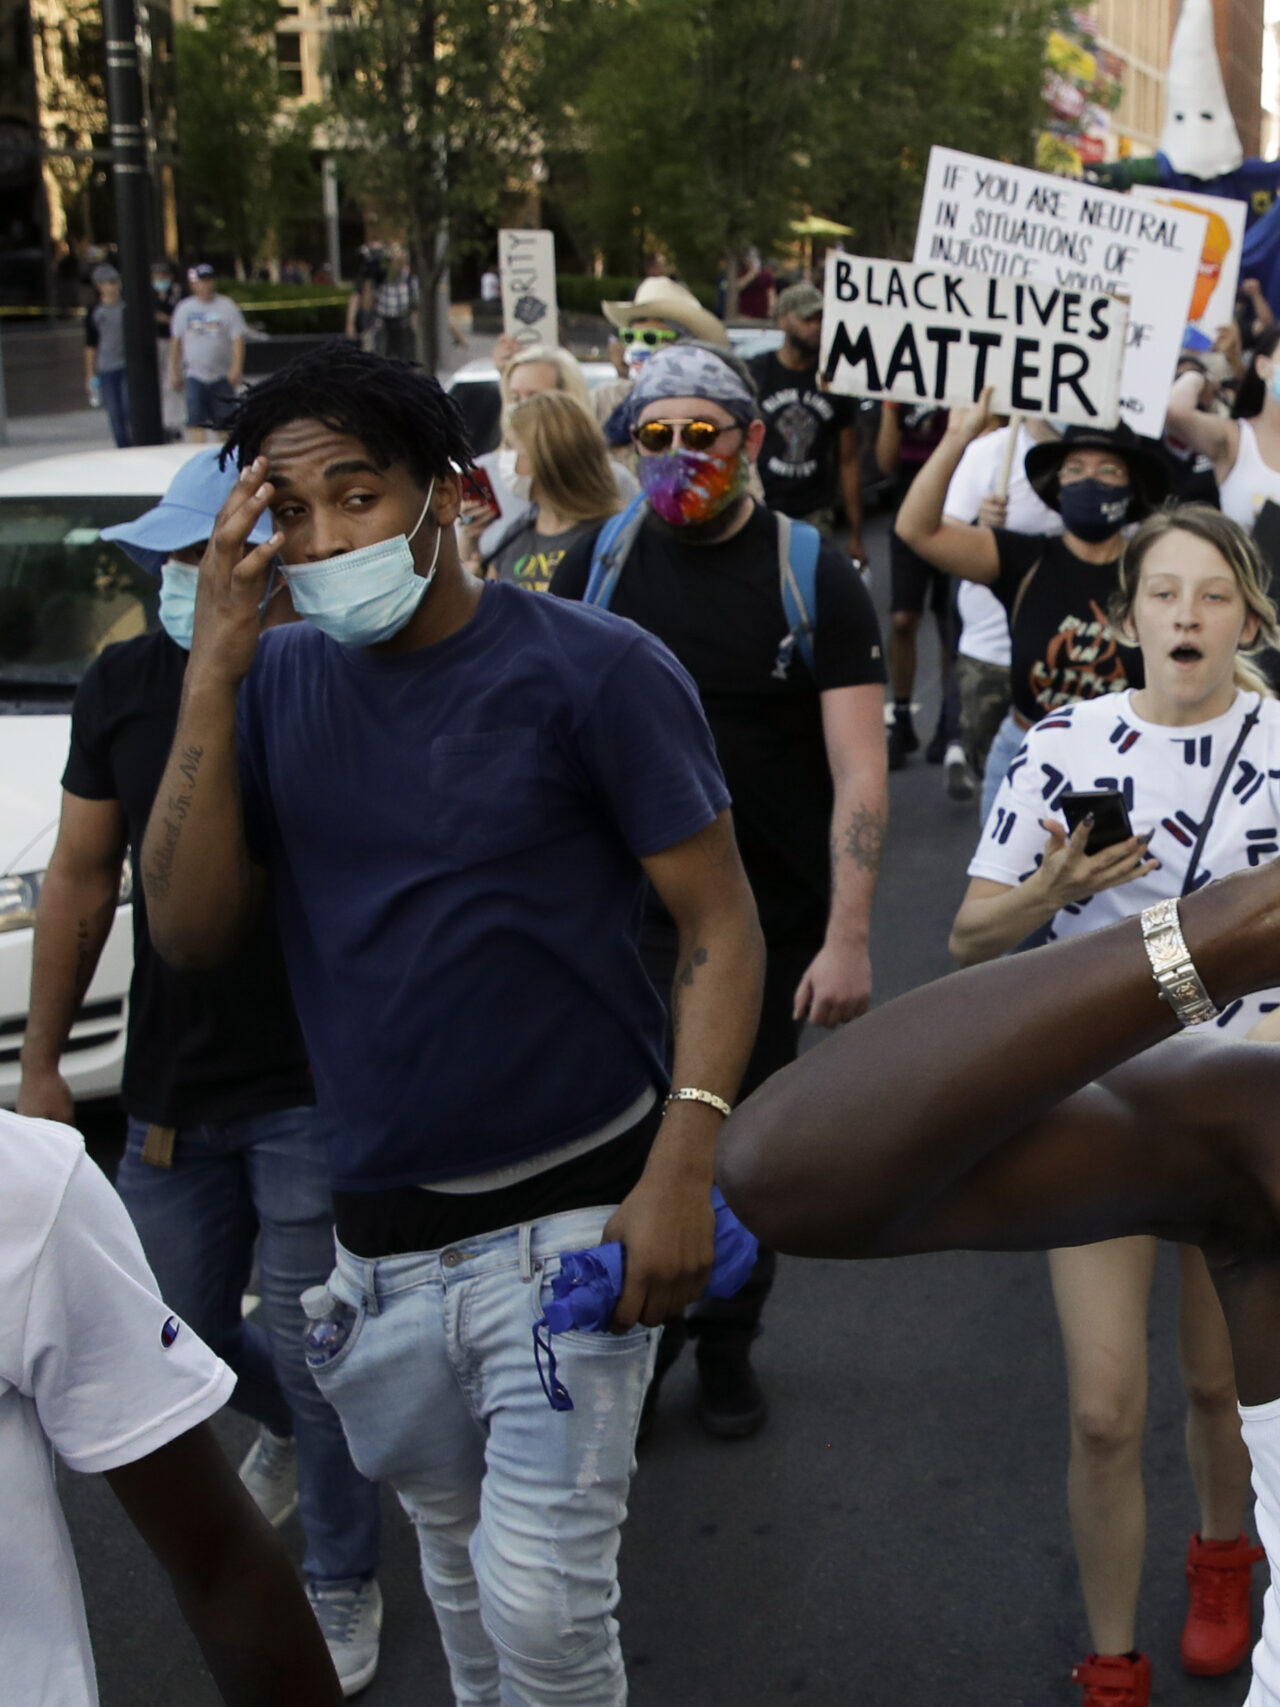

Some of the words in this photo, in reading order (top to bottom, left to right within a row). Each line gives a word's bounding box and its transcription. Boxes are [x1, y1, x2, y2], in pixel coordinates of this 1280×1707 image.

[935, 200, 958, 229] IN
[969, 207, 1093, 266] SITUATIONS
[1103, 241, 1140, 276] OF
[942, 164, 970, 190] IF
[974, 169, 1018, 206] YOU
[1026, 184, 1074, 220] ARE
[1079, 197, 1183, 250] NEUTRAL
[835, 259, 973, 318] BLACK
[987, 278, 1110, 341] LIVES
[825, 320, 1099, 417] MATTER
